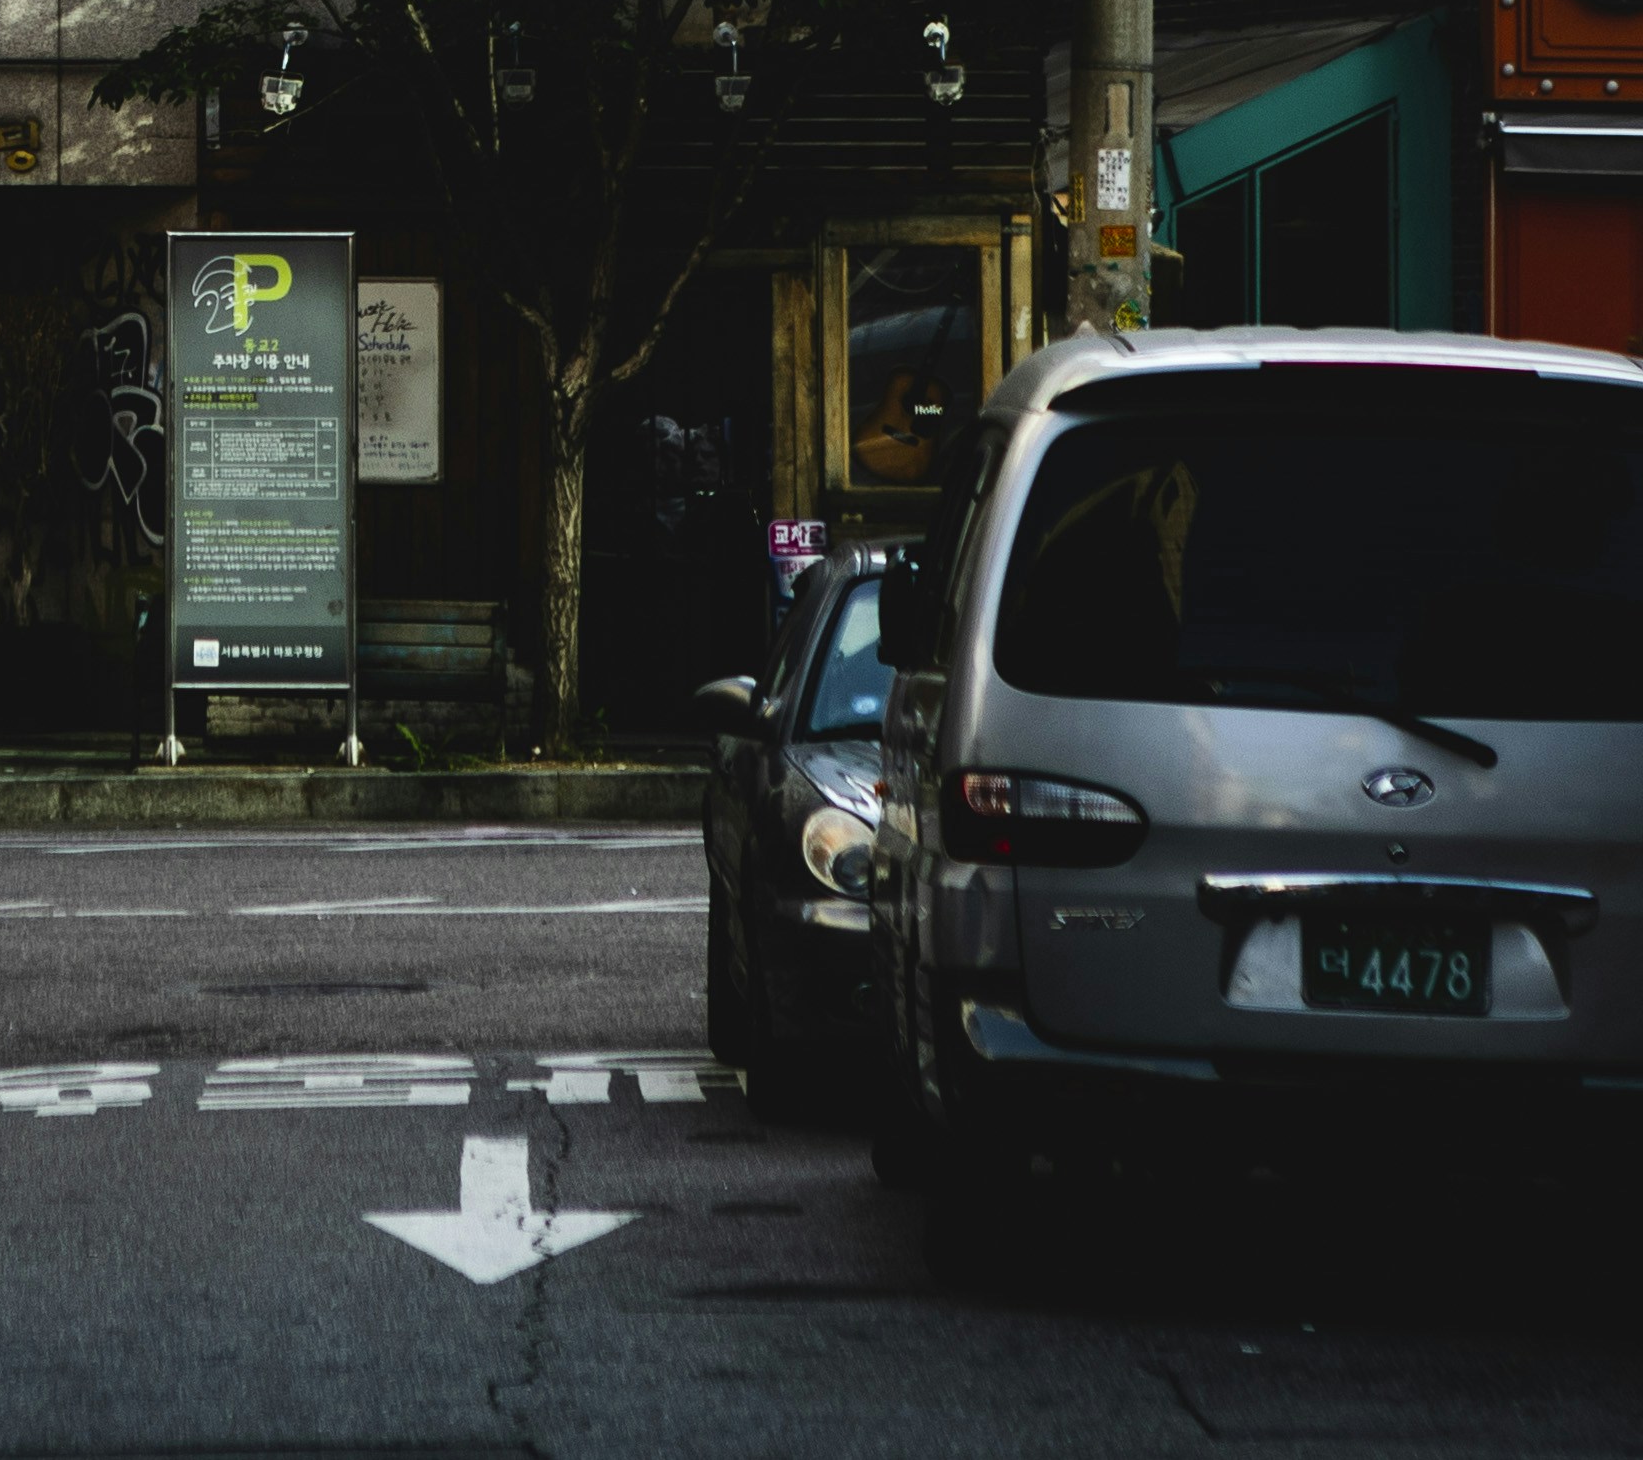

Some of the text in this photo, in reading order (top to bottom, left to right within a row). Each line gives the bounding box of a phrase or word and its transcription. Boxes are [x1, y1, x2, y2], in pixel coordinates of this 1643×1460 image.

[234, 253, 293, 331] P
[212, 354, 310, 370] 주차장 이용 안내
[1358, 946, 1474, 1001] 4478
